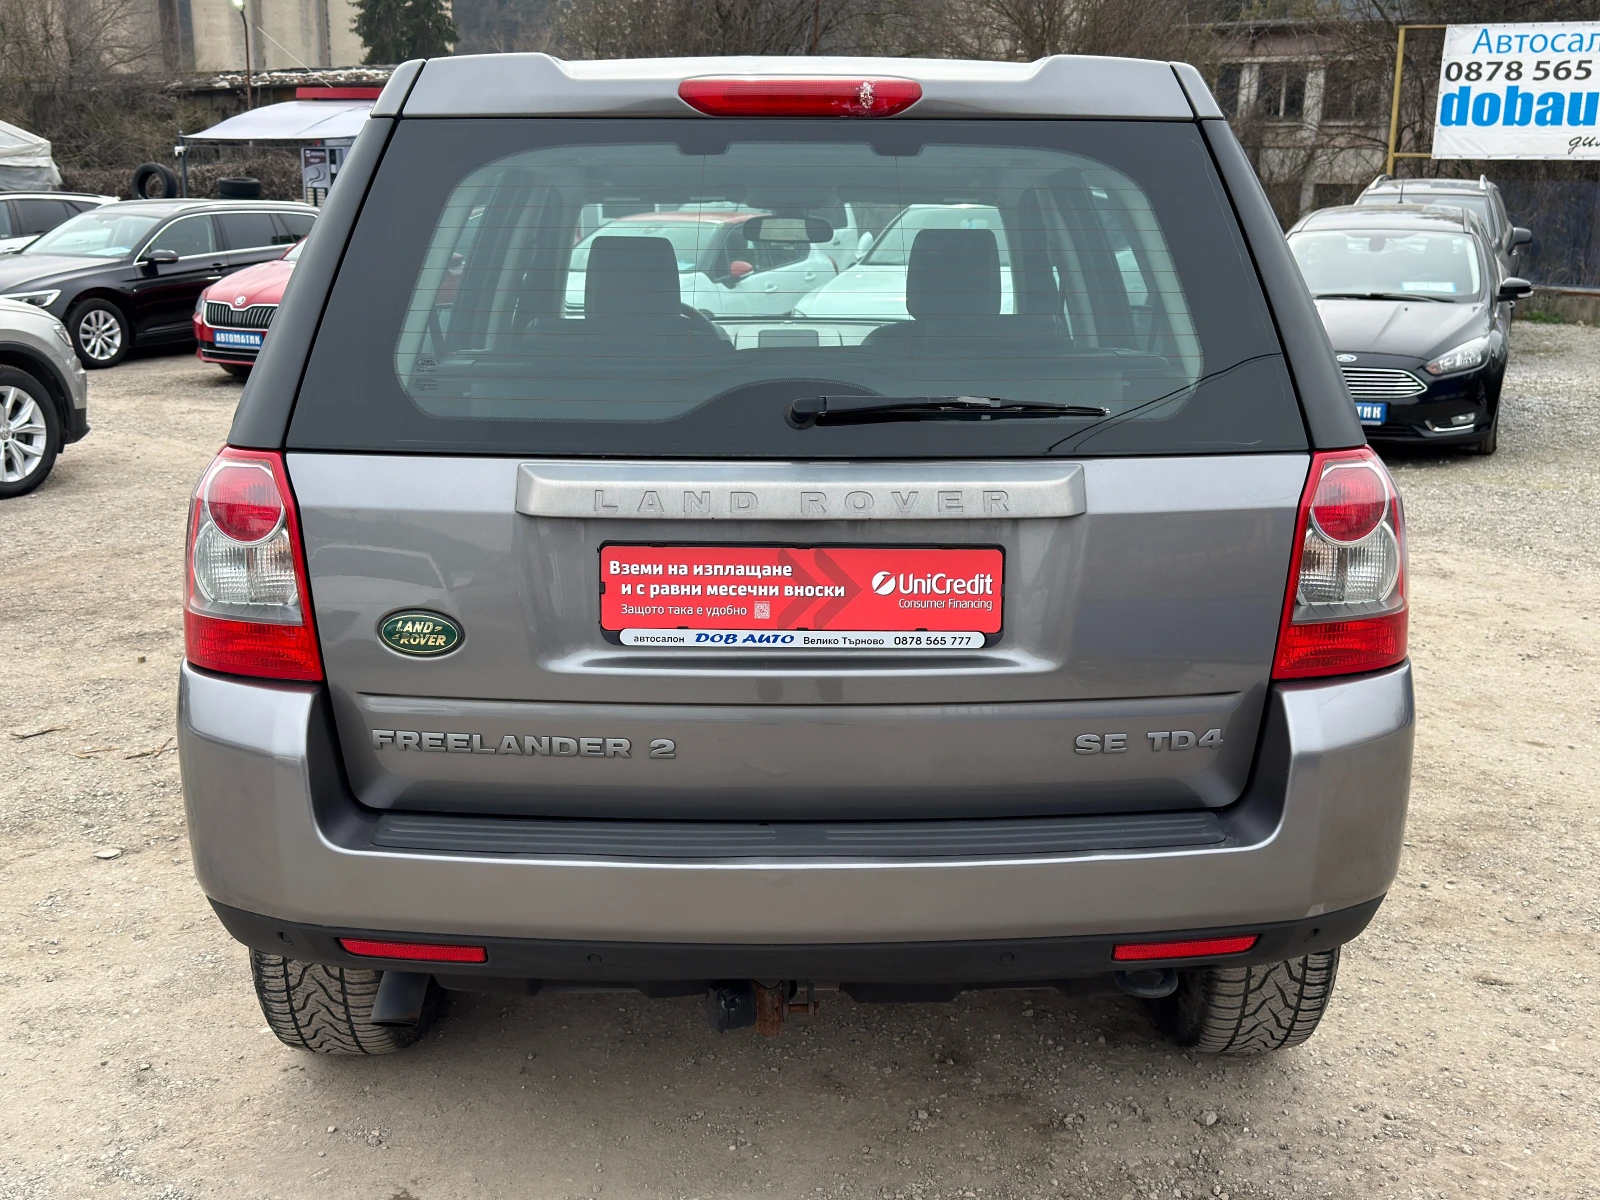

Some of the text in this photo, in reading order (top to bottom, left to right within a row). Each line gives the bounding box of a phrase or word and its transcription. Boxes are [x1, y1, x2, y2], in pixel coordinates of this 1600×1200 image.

[1445, 59, 1593, 82] 0878 565
[1440, 85, 1600, 127] dobau
[216, 332, 261, 345] АВТОМАТИК
[593, 489, 1011, 513] LAND ROVER
[609, 560, 793, 578] Вземи на изплащане
[621, 583, 845, 599] и с равни месечни вноски
[899, 572, 993, 595] UniCredit
[621, 604, 747, 618] Защото така е удобно
[898, 598, 993, 612] Consumer Financing
[399, 633, 447, 646] ROVER
[633, 635, 685, 644] автосалон
[695, 633, 738, 645] DOB
[803, 636, 840, 645] Велико
[842, 636, 885, 647] Търново
[893, 636, 922, 646] 0878
[925, 636, 947, 646] 565
[950, 636, 972, 646] 777
[371, 728, 676, 759] FREELANDER 2
[1074, 728, 1224, 755] SE TD4
